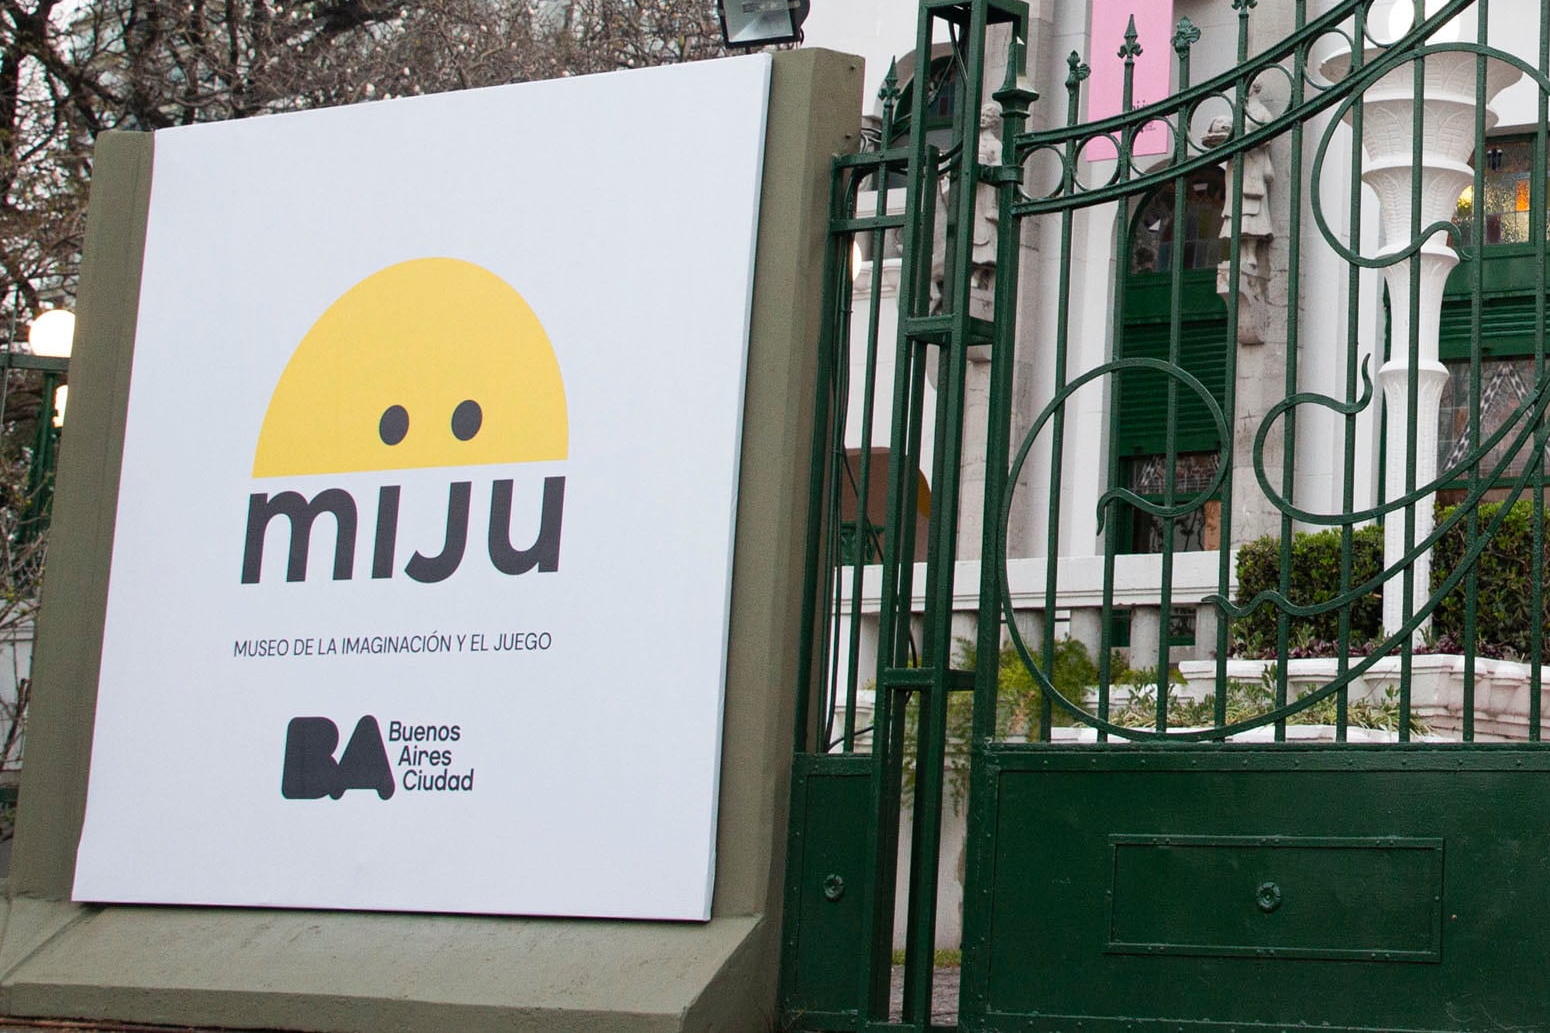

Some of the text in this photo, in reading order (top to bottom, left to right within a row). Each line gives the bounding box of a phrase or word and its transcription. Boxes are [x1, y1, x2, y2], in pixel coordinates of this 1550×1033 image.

[241, 476, 566, 584] miju
[233, 630, 552, 657] MUSEO DE LA IMAGINACIÓN Y EL JUEGO
[389, 721, 461, 742] Buenos
[281, 714, 396, 800] BA
[398, 746, 452, 766] Aires
[402, 768, 474, 791] Ciudad
